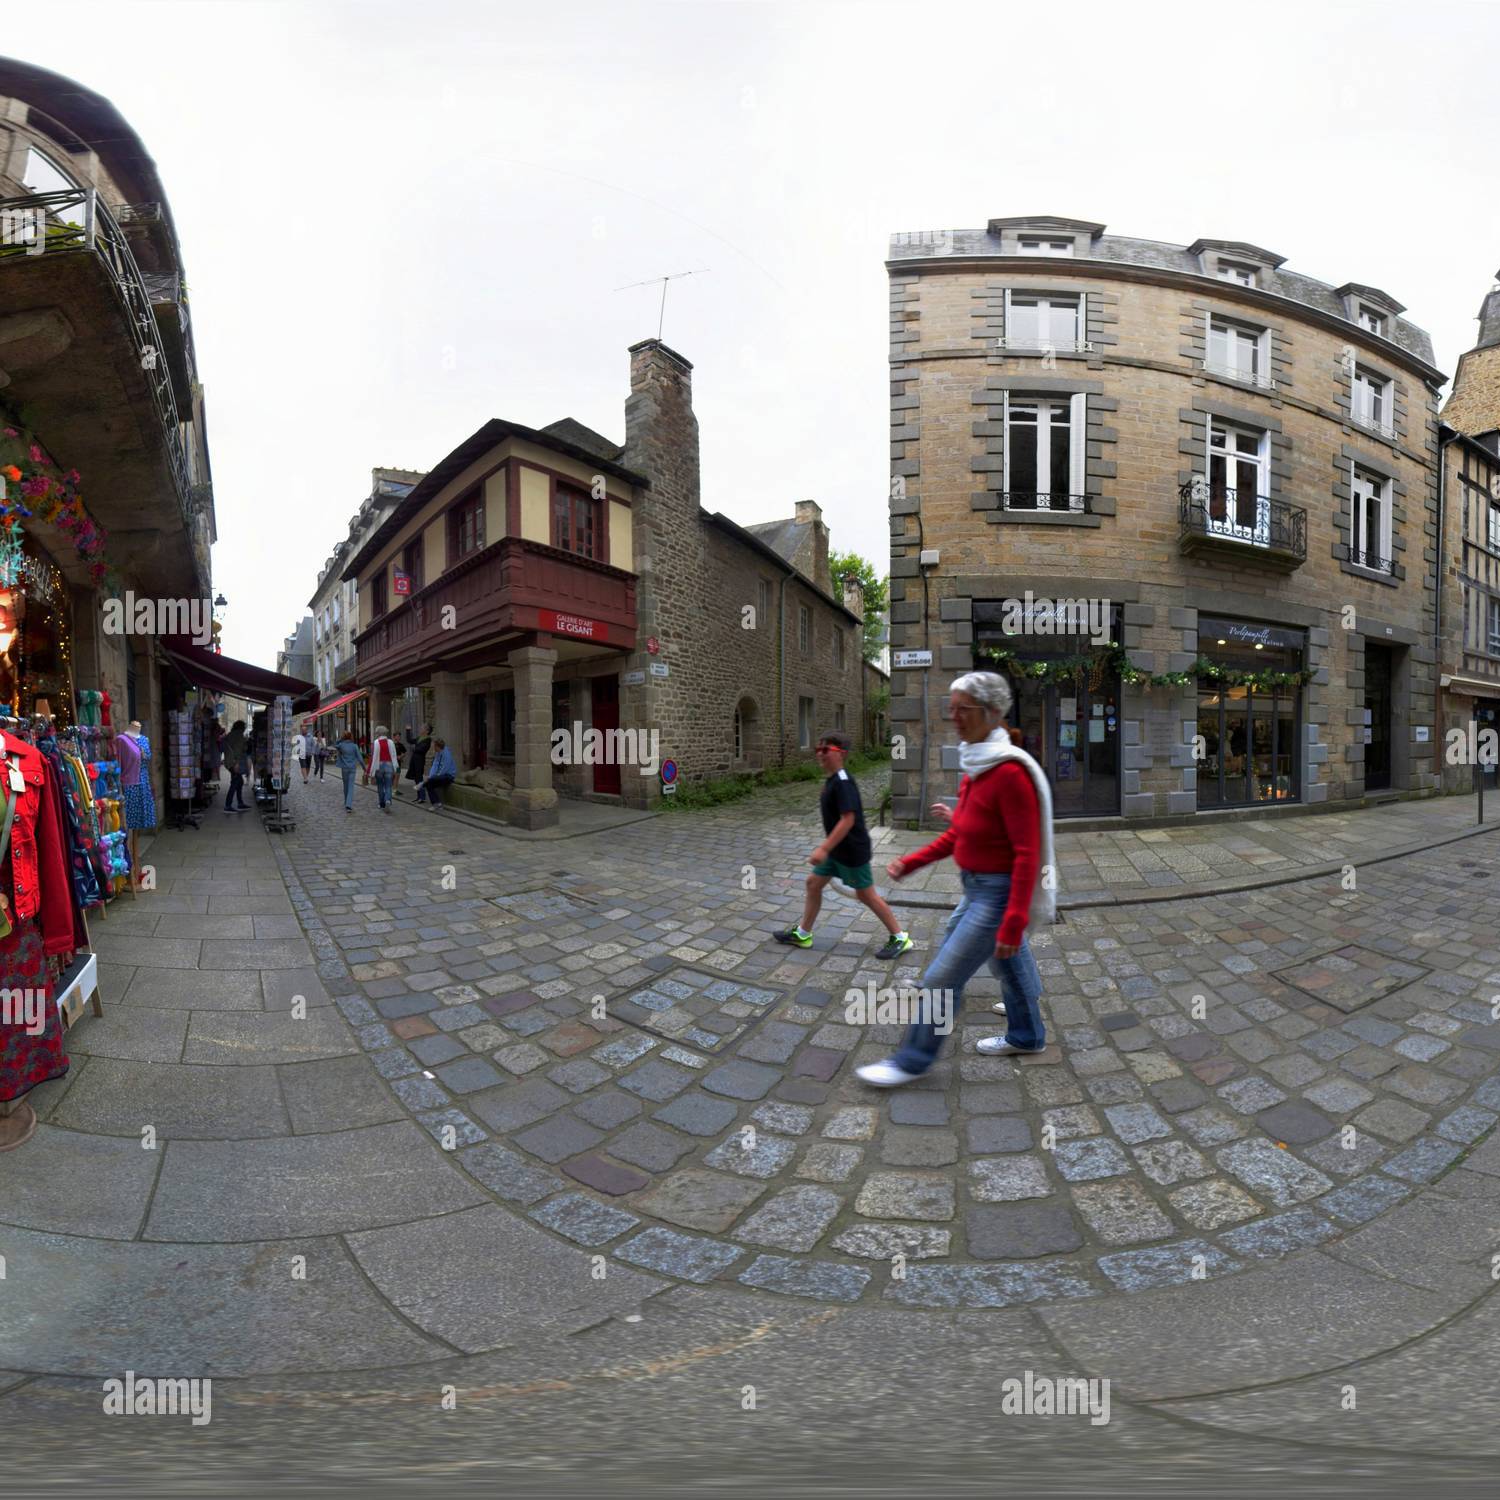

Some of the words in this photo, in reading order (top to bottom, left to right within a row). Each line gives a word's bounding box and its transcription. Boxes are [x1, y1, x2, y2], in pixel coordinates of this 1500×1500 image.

[556, 614, 577, 625] GALERIE
[556, 621, 565, 631] LE
[566, 623, 593, 637] GISANT
